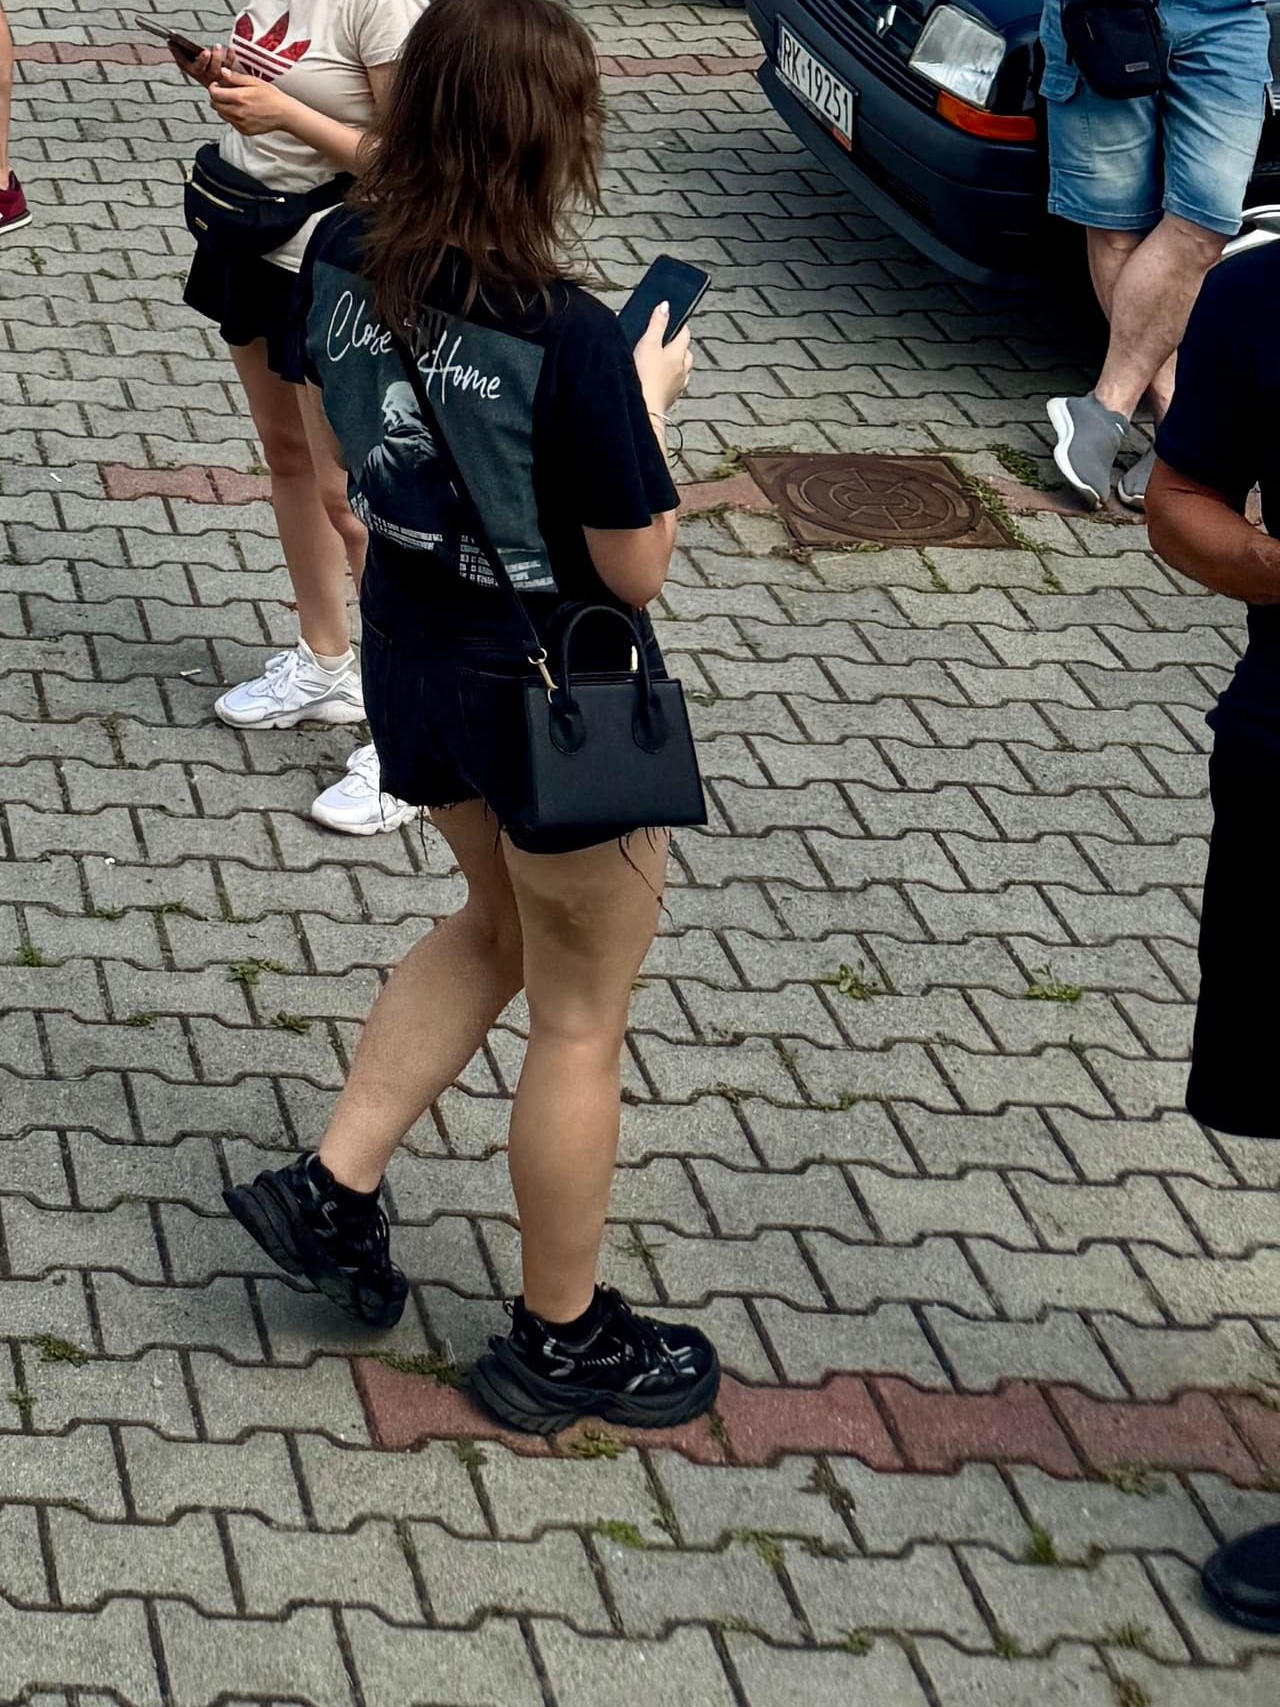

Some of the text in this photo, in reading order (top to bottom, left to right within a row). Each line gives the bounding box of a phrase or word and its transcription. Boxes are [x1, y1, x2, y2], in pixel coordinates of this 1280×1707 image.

[783, 33, 849, 133] RK 19251
[326, 290, 393, 363] Close
[417, 330, 502, 405] Home
